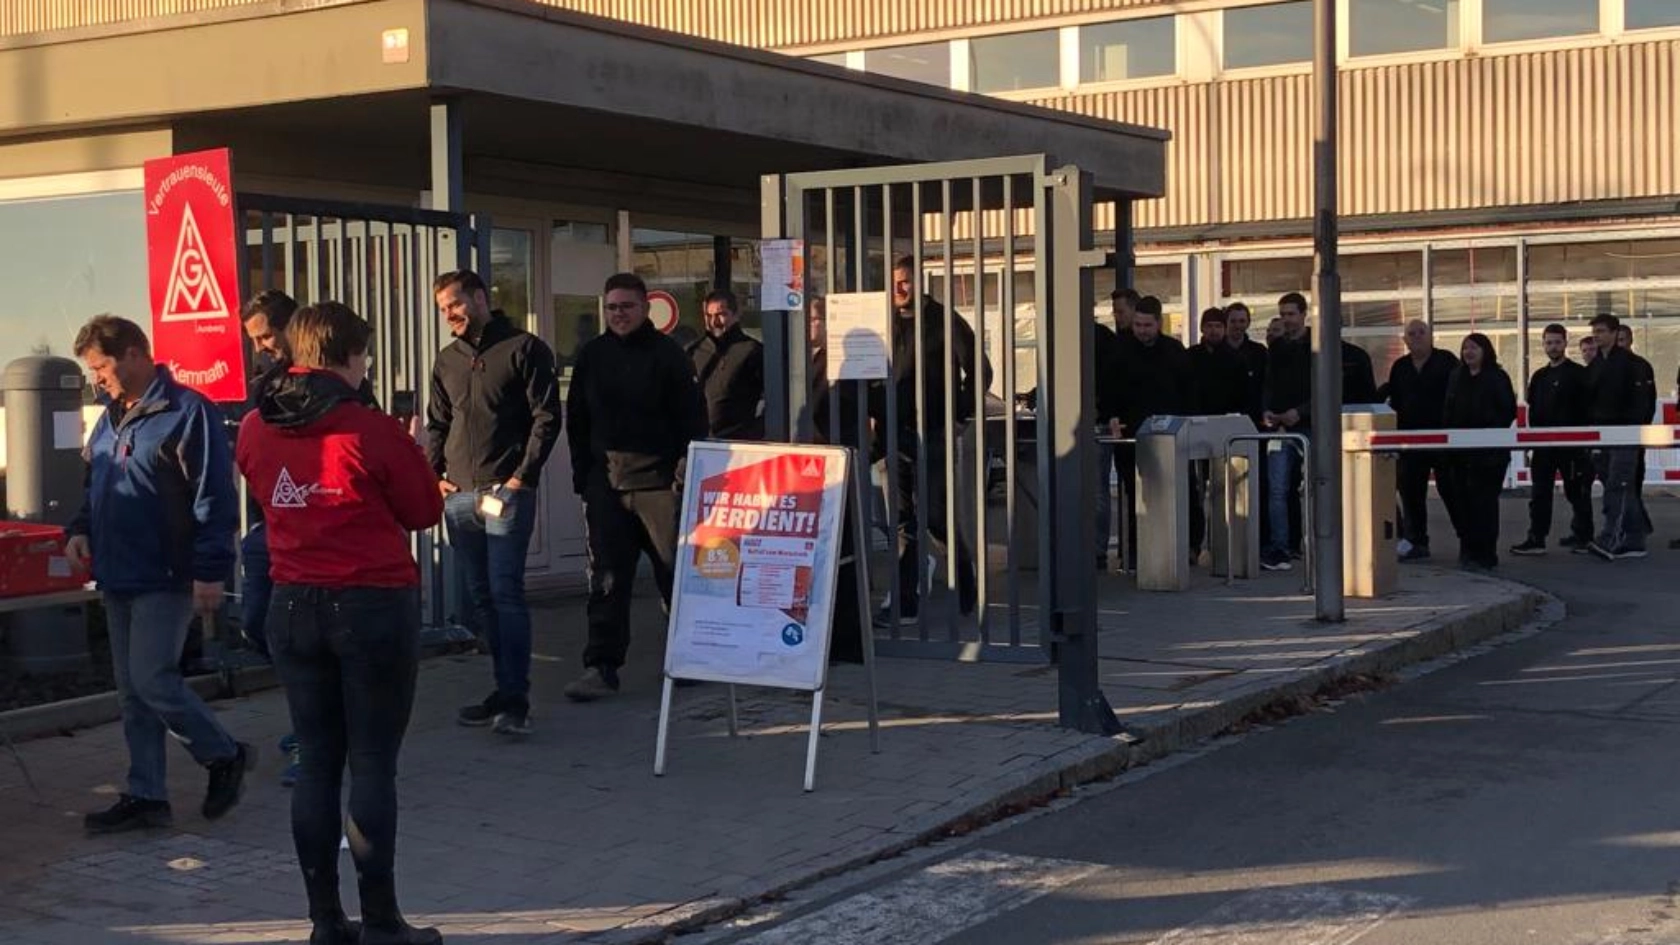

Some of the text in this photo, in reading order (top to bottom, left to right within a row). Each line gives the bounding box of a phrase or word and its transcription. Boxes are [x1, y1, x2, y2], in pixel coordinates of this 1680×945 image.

[148, 164, 230, 215] Vertrauensleute
[168, 359, 230, 385] Kemnath
[703, 491, 731, 505] WIR
[780, 495, 797, 510] ES
[703, 506, 816, 533] VERDIENT!
